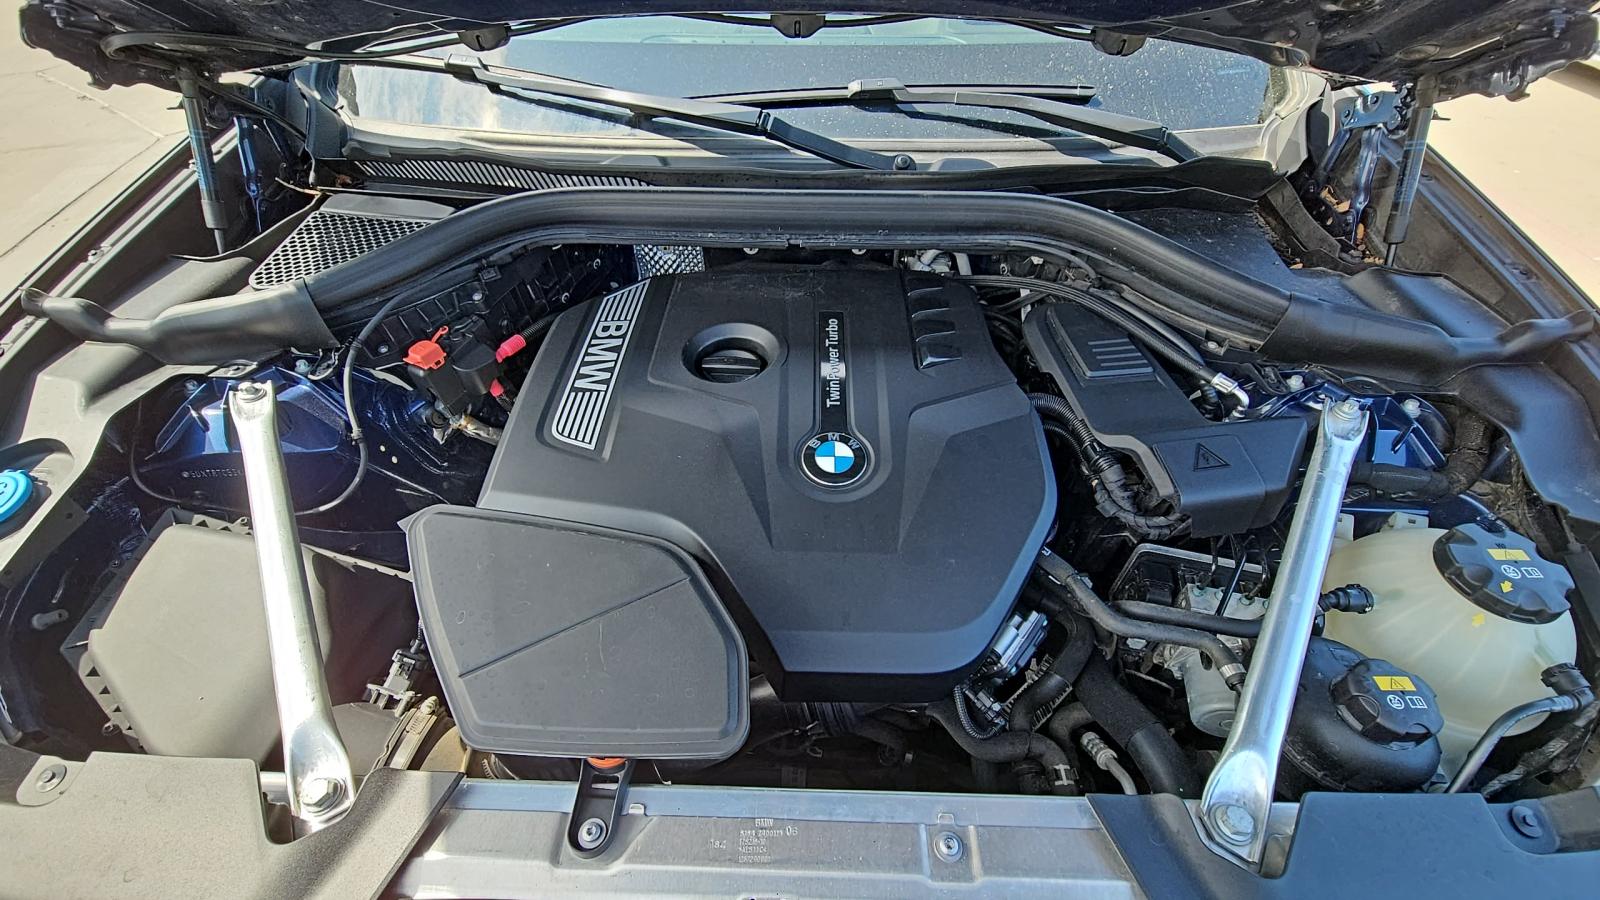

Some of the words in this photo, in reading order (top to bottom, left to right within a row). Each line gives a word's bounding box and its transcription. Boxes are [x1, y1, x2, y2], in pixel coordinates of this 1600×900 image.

[825, 318, 839, 346] Turbo
[574, 320, 630, 391] BMW
[826, 347, 841, 408] TwinPower
[808, 432, 860, 449] BMW
